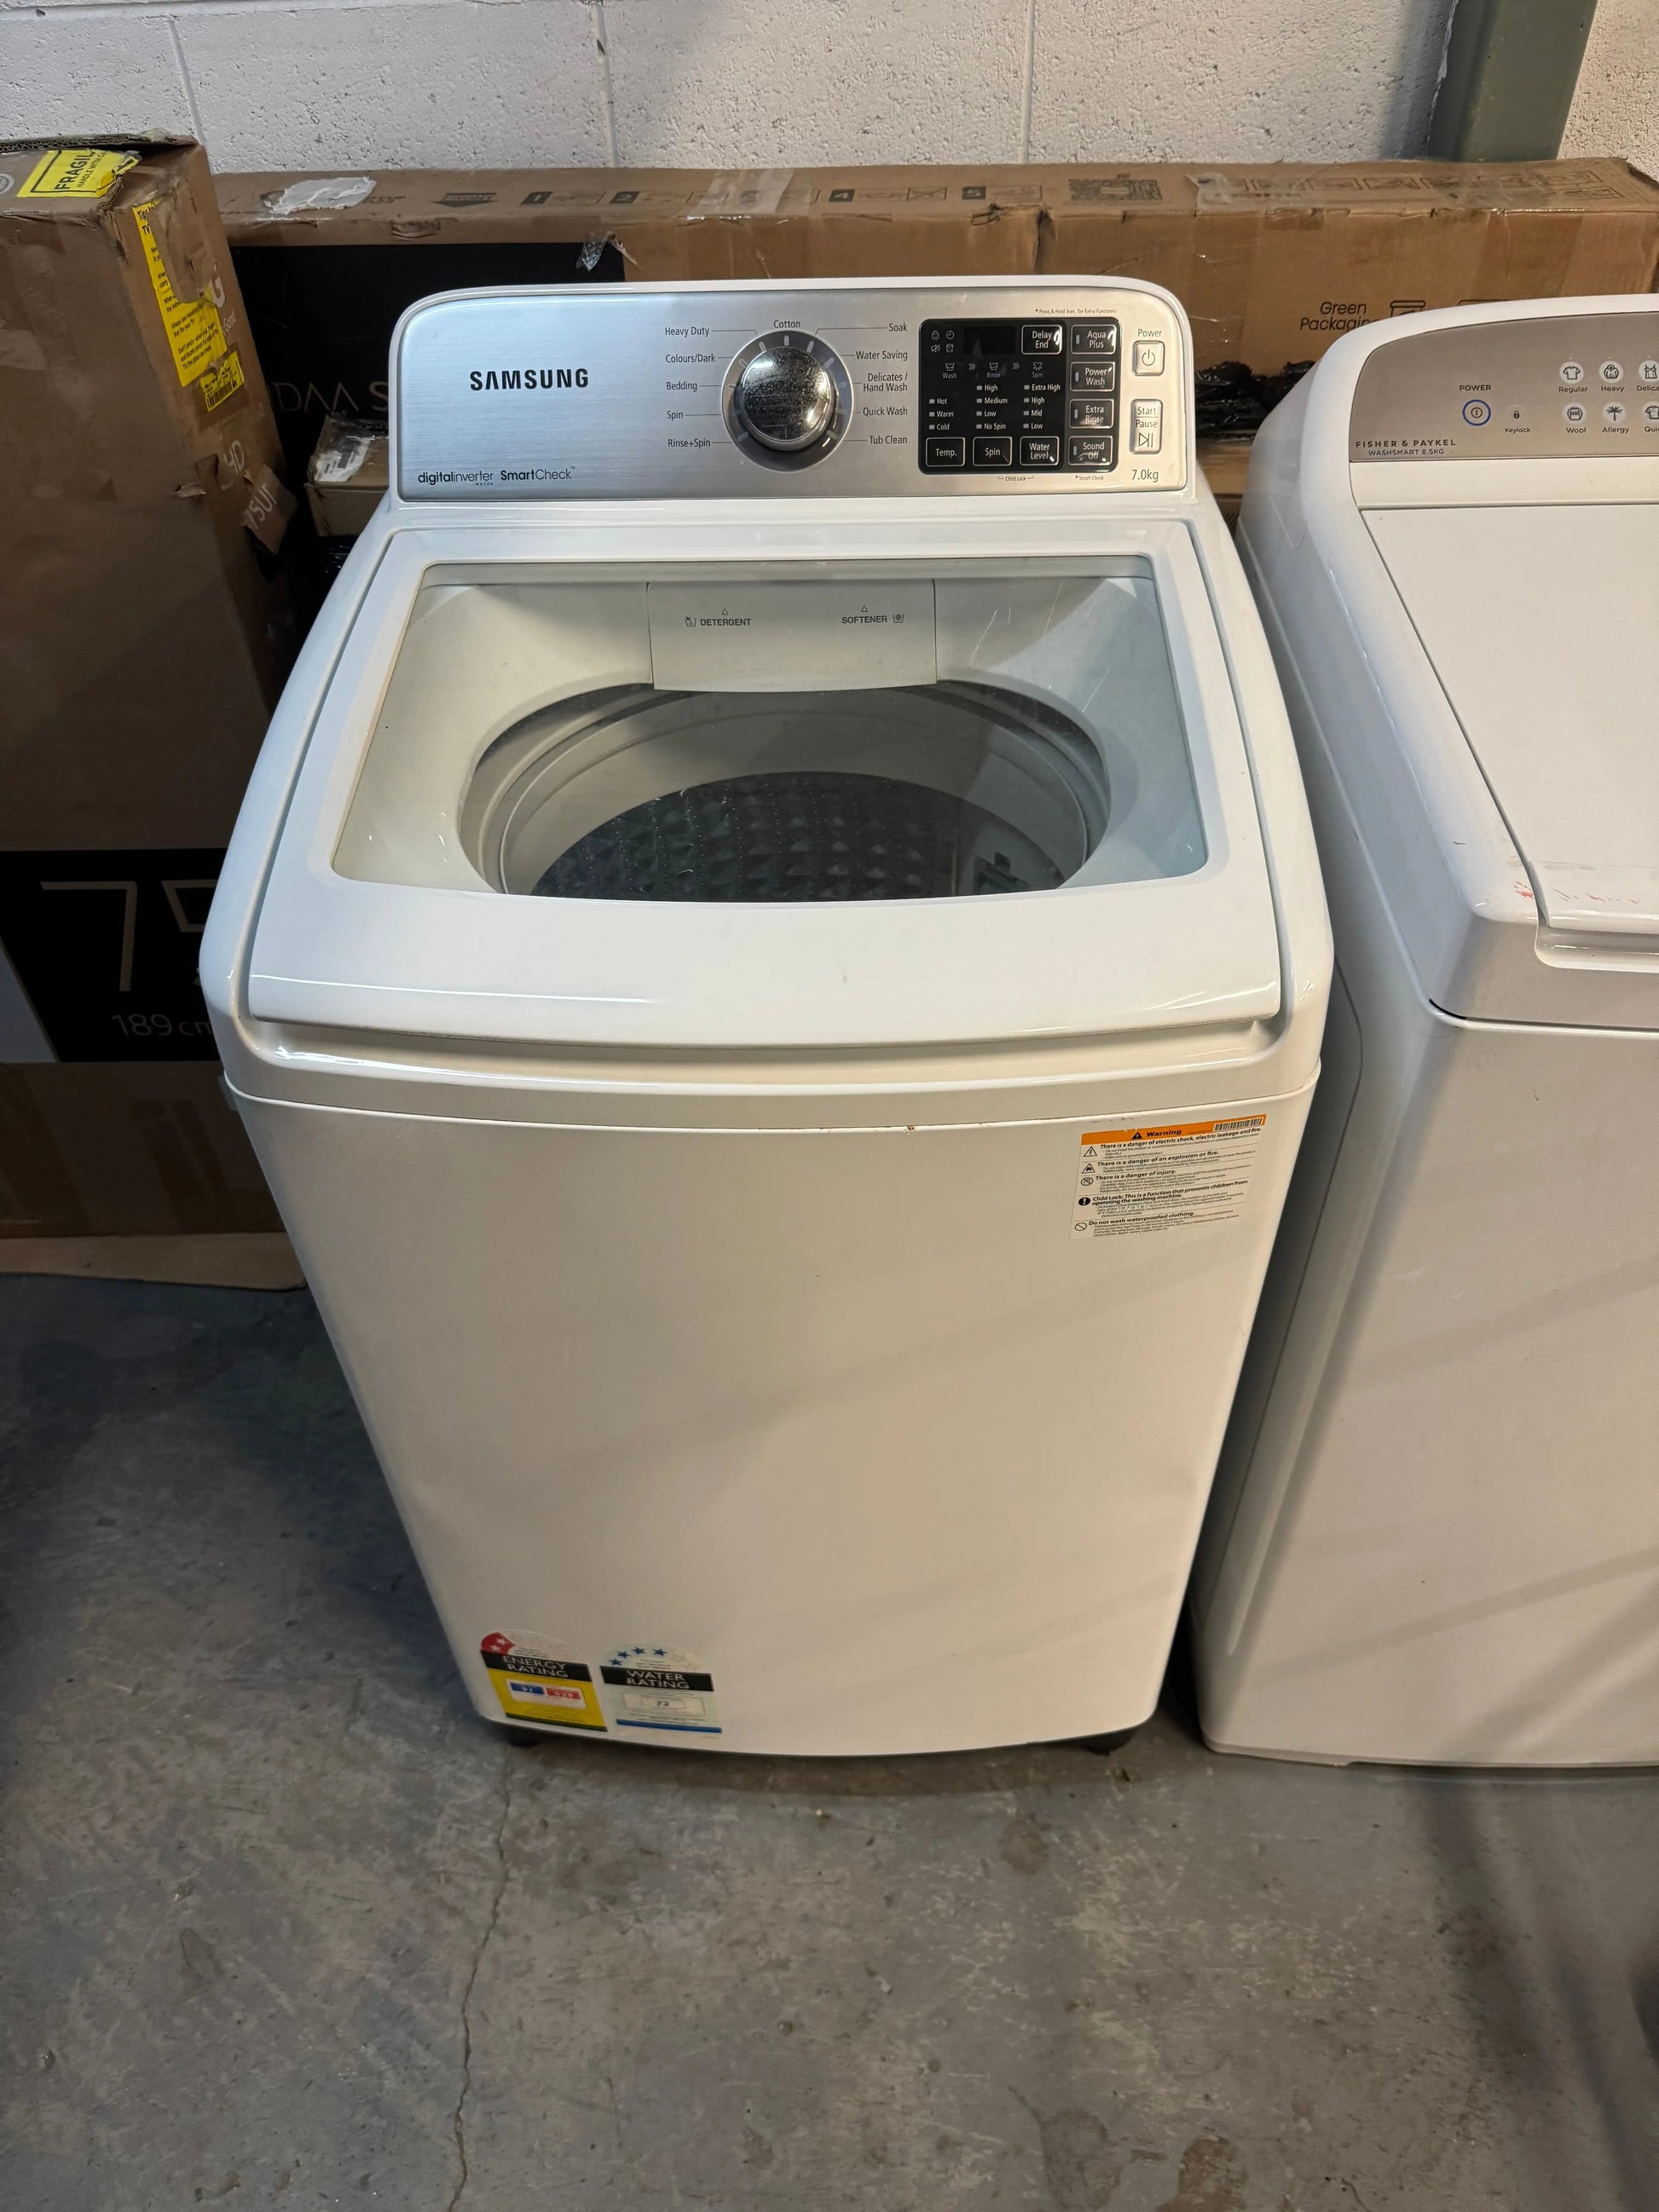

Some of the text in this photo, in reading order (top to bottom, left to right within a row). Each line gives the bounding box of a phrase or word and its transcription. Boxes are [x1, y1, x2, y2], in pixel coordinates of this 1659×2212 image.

[54, 150, 96, 190] FRAGIL
[1320, 301, 1367, 315] Green
[773, 320, 801, 329] Cotton
[888, 323, 908, 332] Soak
[665, 326, 709, 337] Heavy Duty
[1032, 331, 1052, 341] Delay
[1087, 331, 1107, 341] Aqua
[1137, 329, 1162, 338] Power
[1089, 340, 1104, 349] Plus
[665, 353, 716, 363] Colours/Dark
[855, 350, 908, 361] Water Saving
[470, 367, 589, 391] SAMSUNG
[867, 373, 902, 382] Delicates
[1085, 378, 1106, 386] Wash
[666, 381, 697, 392] Bedding
[863, 383, 908, 392] Hand Wash
[985, 384, 998, 393] High
[1047, 384, 1061, 392] High
[667, 410, 684, 420] Spin
[863, 407, 908, 418] Quick Wash
[1137, 407, 1157, 415] Start
[1085, 415, 1104, 424] Rinse
[1135, 419, 1158, 428] Pause
[993, 423, 1006, 431] Spin
[1602, 426, 1630, 435] Allergy
[668, 438, 711, 448] Rinse+Spin
[870, 436, 908, 444] Tub Clean
[1413, 439, 1457, 448] PAYKEL
[1083, 442, 1105, 451] Sound
[935, 448, 957, 458] Temp.
[985, 448, 1001, 458] Spin
[1088, 451, 1100, 459] Off
[1131, 470, 1159, 482] 7.0kg
[700, 618, 751, 627] DETERGENT
[112, 1014, 172, 1036] 189
[503, 1655, 567, 1670] ENERGY
[507, 1663, 569, 1678] RATING
[627, 1670, 685, 1681] WATER
[627, 1678, 690, 1689] RATING
